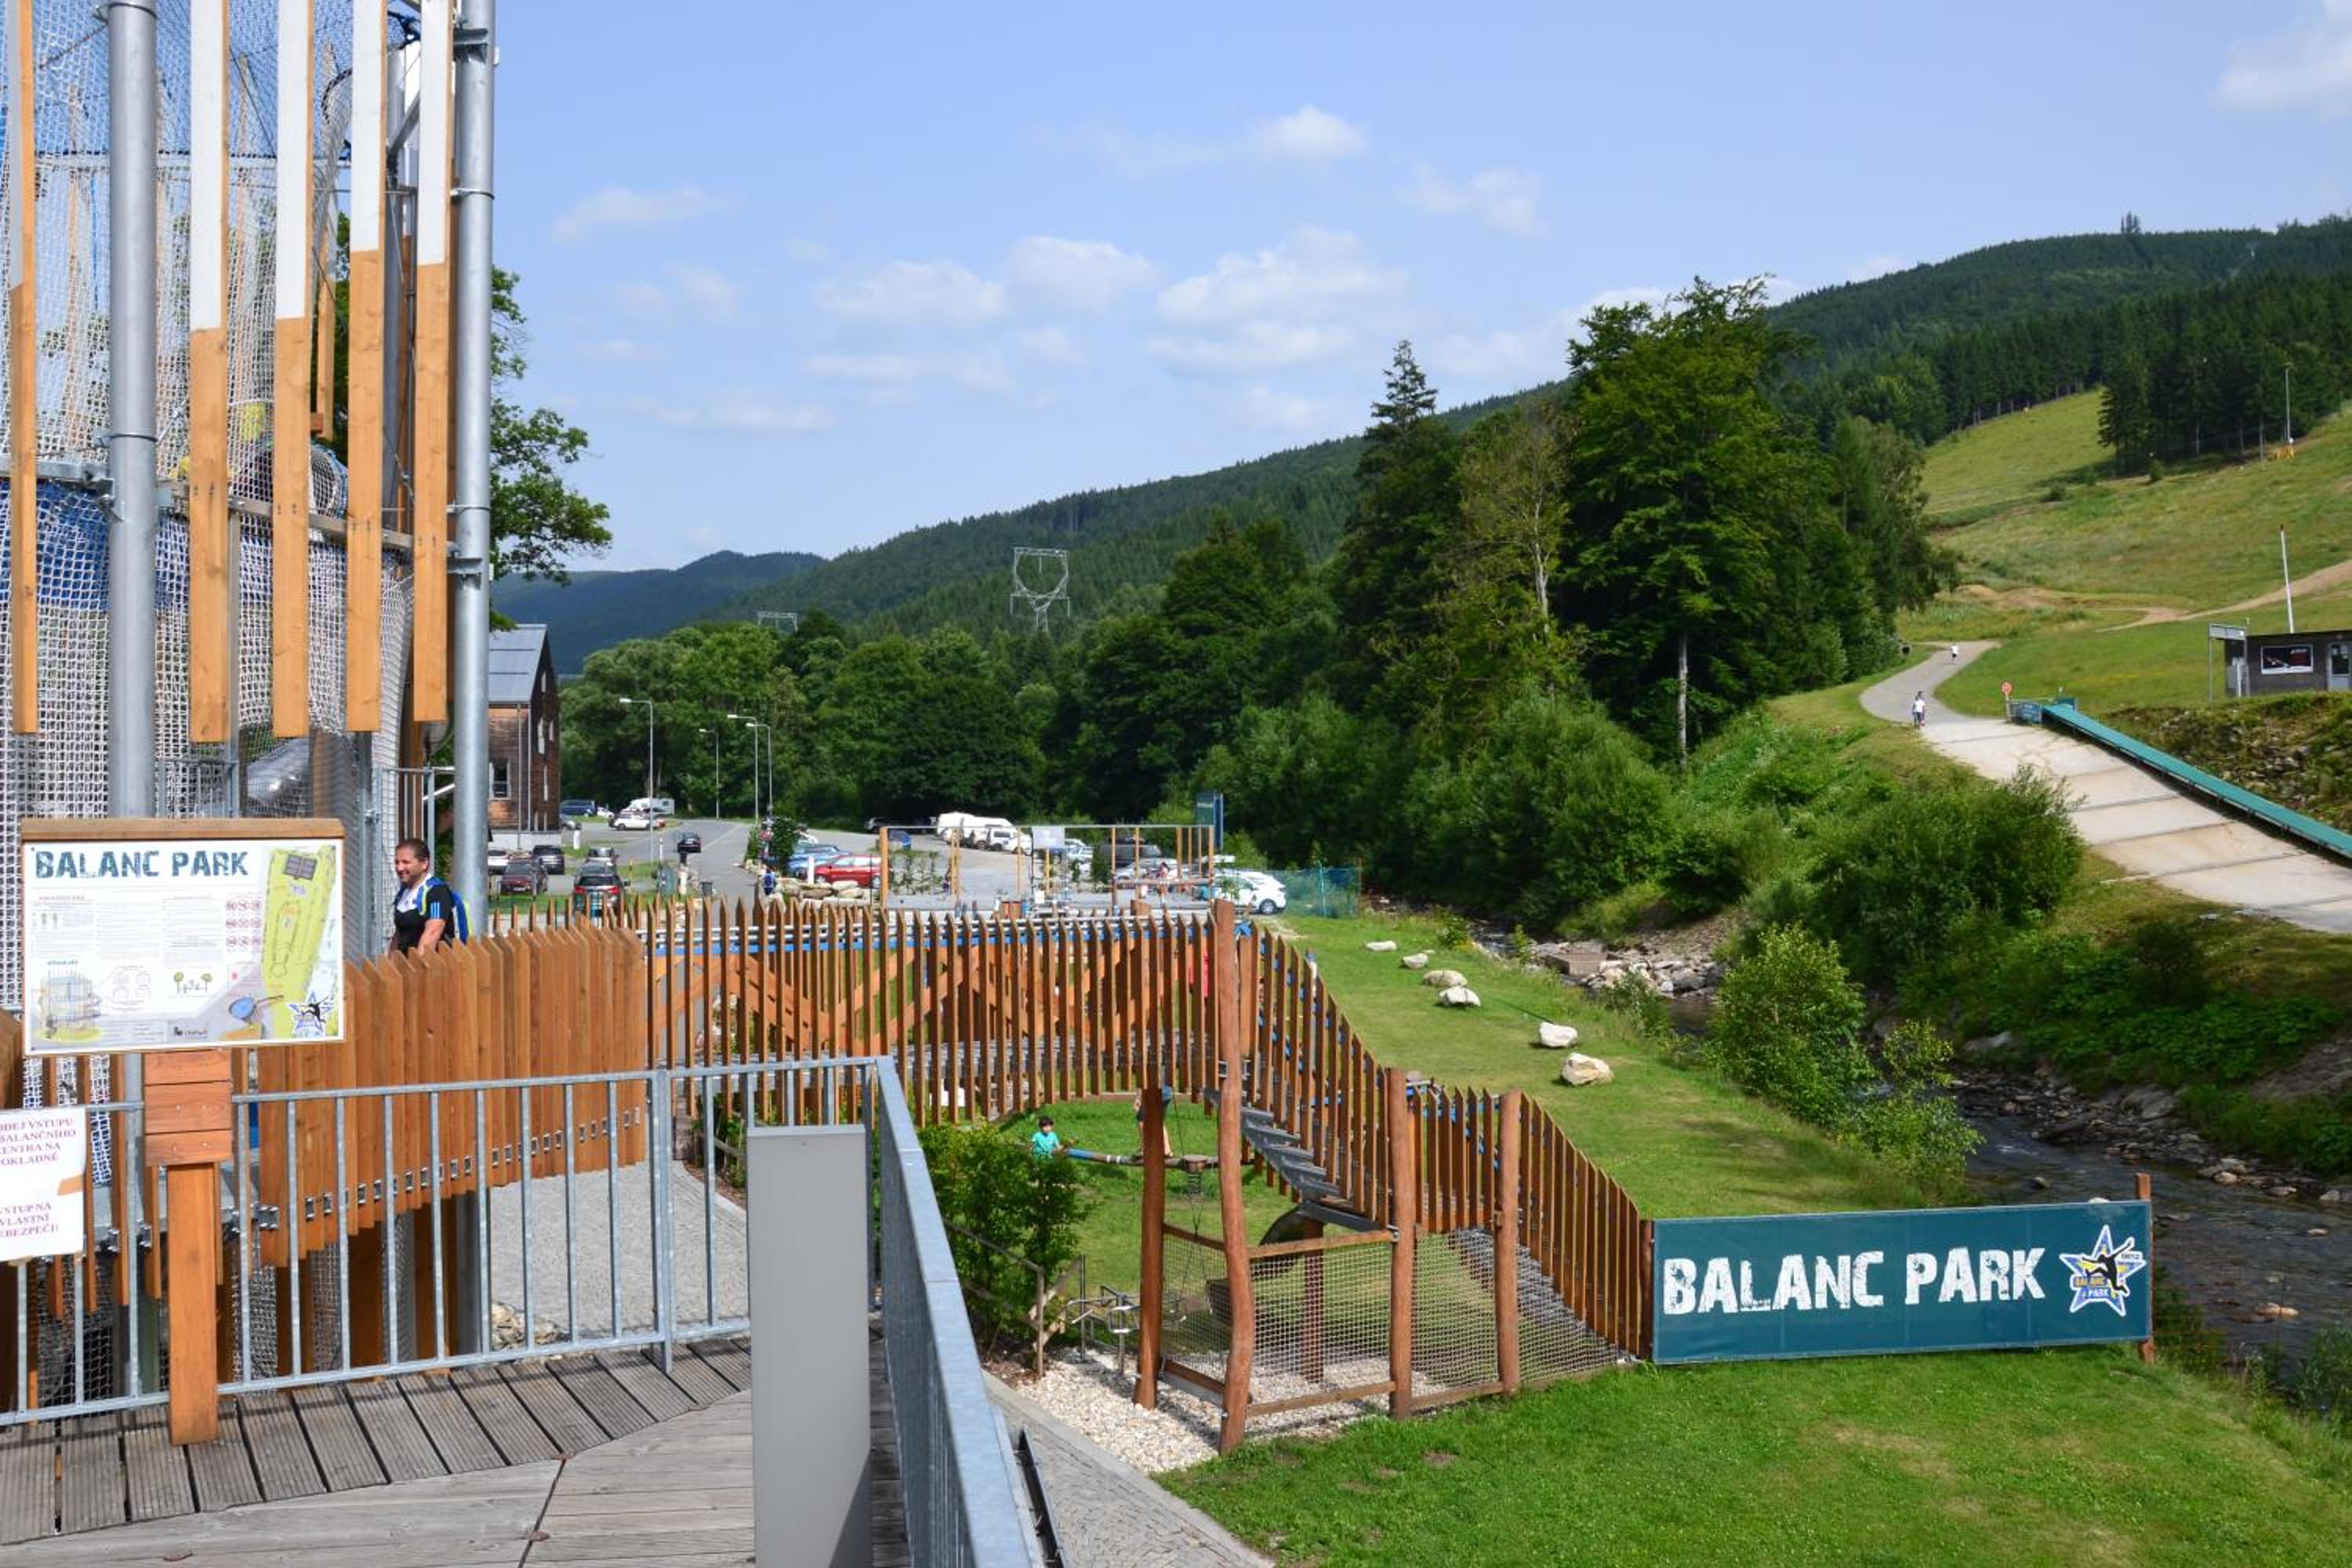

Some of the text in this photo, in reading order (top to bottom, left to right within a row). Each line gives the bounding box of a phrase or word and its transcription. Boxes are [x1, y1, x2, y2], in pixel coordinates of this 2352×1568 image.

[35, 851, 249, 879] BALANC PARK
[0, 1143, 42, 1155] ENTRA
[1663, 1247, 2045, 1315] BALANC PARK
